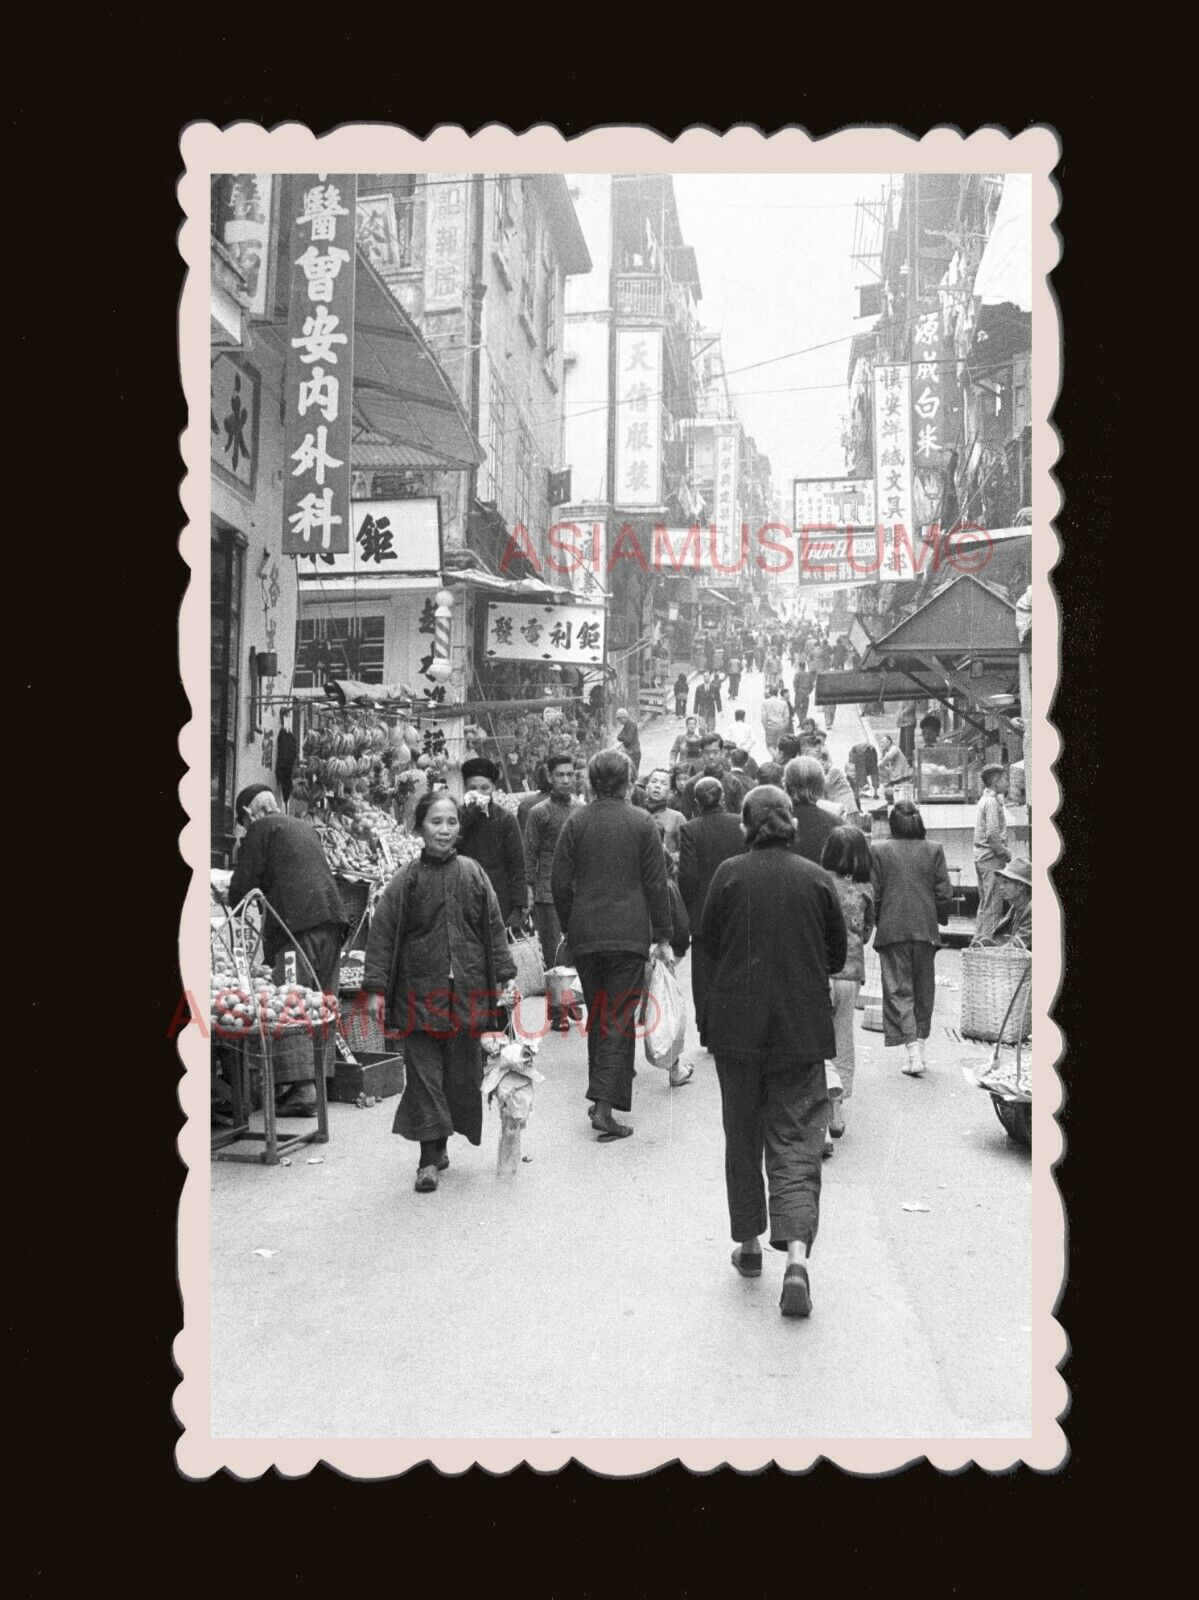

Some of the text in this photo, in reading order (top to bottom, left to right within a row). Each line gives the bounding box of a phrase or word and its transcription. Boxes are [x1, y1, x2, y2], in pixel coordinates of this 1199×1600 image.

[289, 174, 350, 549] 醫曾安內外科
